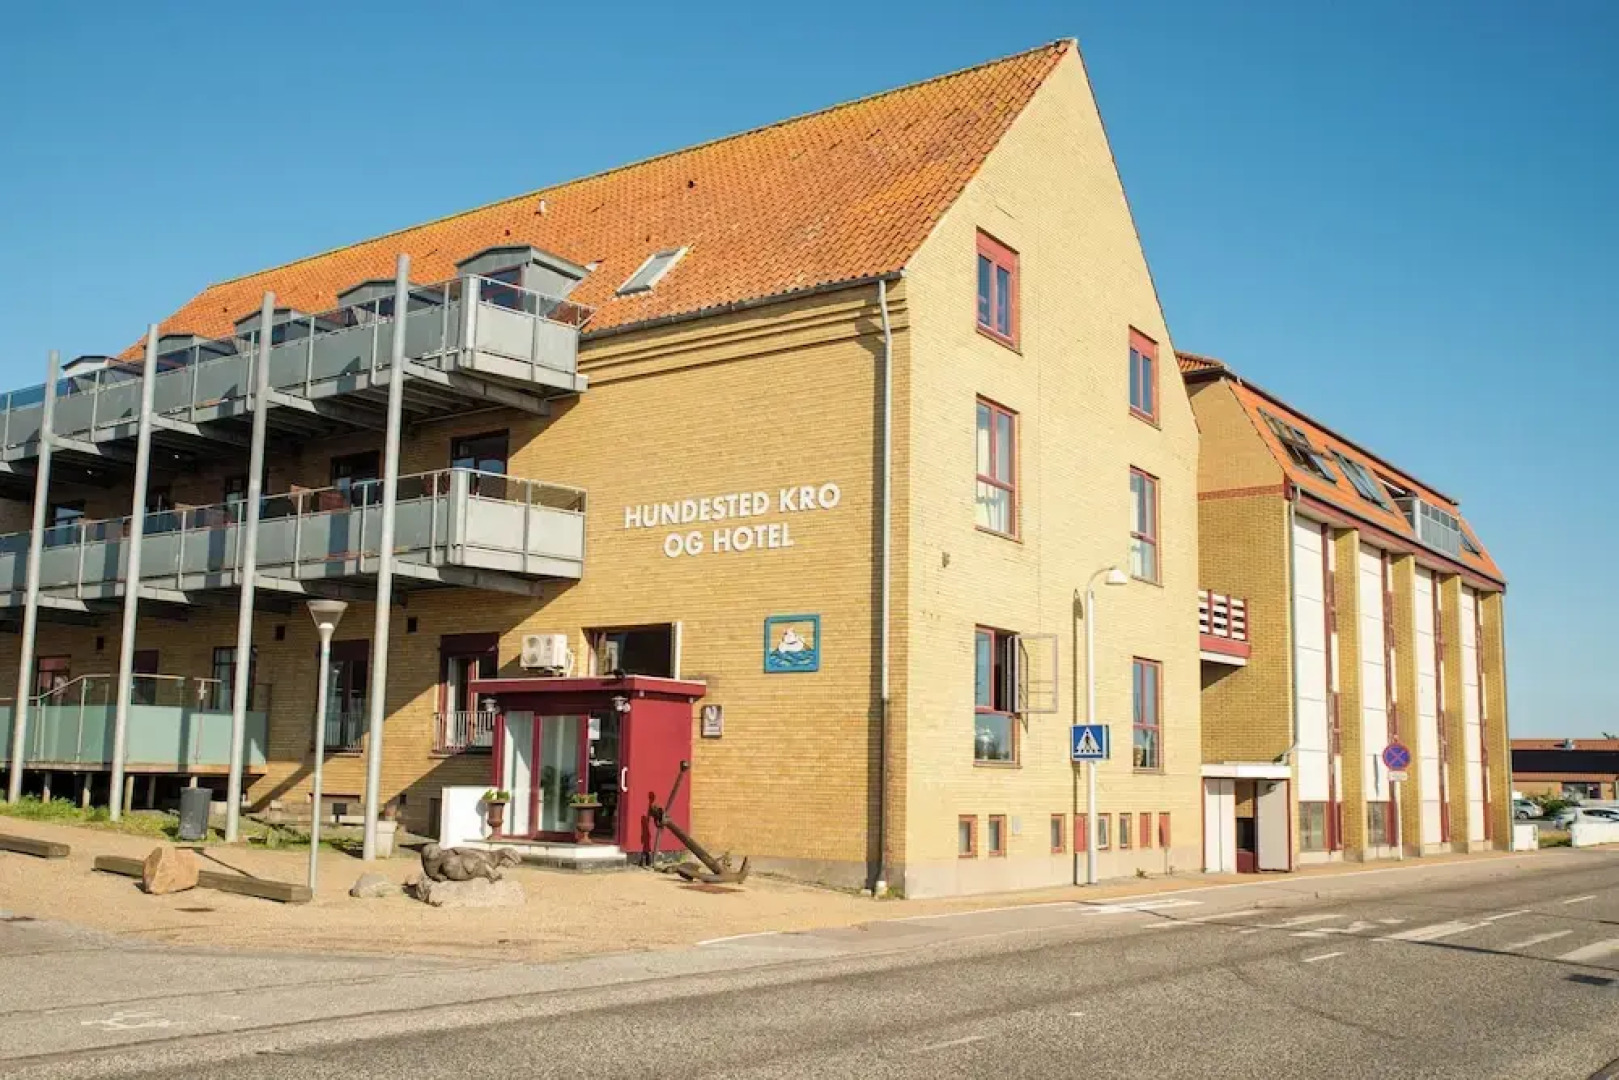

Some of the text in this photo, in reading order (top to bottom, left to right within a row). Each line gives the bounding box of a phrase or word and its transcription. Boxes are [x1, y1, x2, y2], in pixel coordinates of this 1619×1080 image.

[624, 483, 841, 529] HUNDESTED KRO
[663, 523, 795, 558] OG HOTEL
